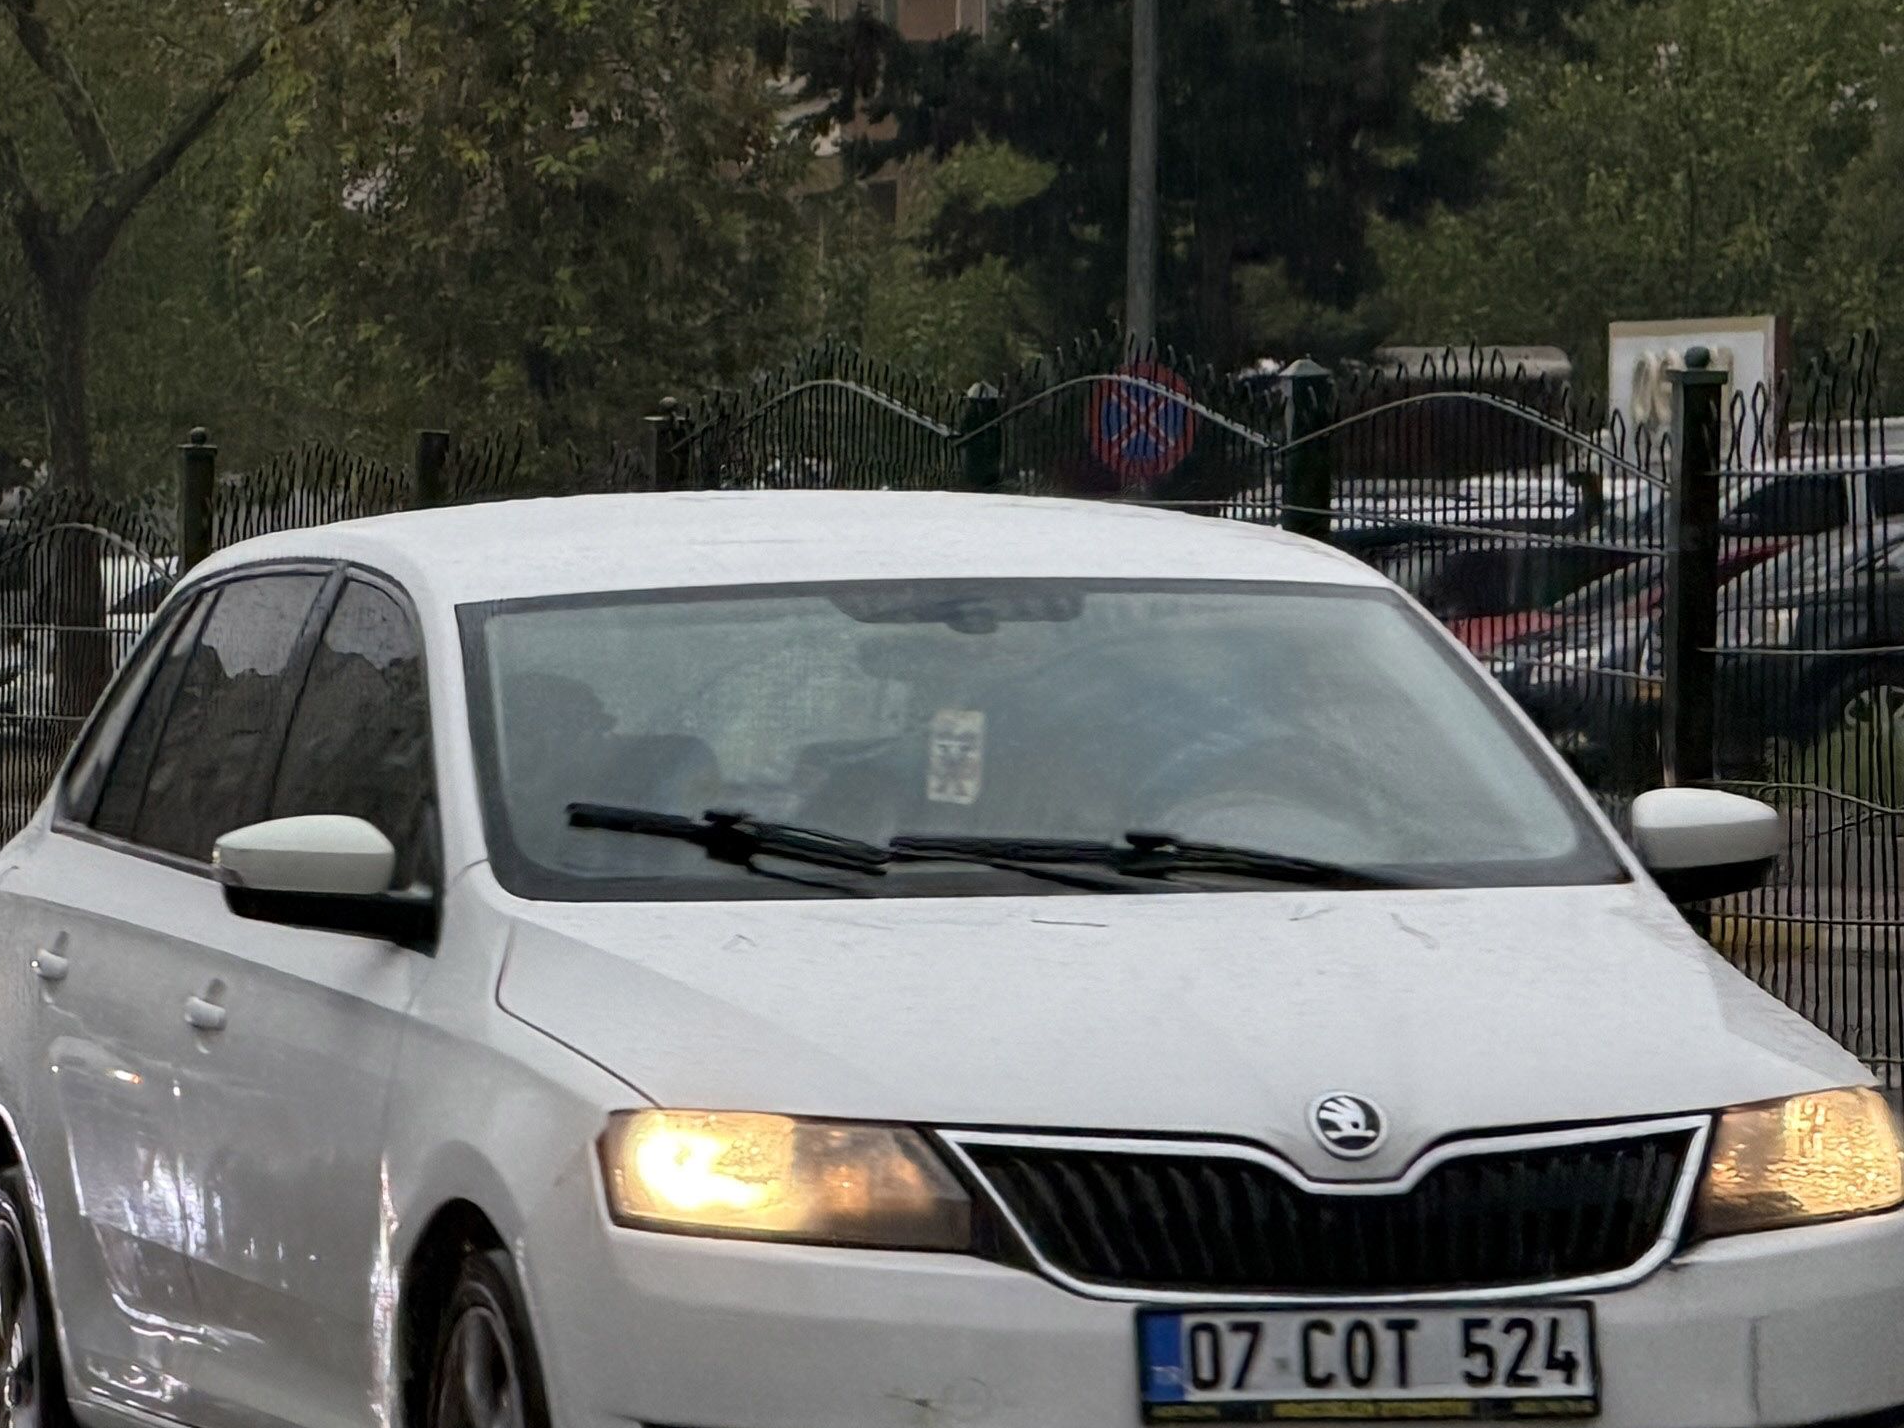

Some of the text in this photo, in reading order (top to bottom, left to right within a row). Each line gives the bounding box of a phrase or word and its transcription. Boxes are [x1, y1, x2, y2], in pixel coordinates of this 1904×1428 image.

[1190, 1317, 1579, 1391] 07 COT 524
